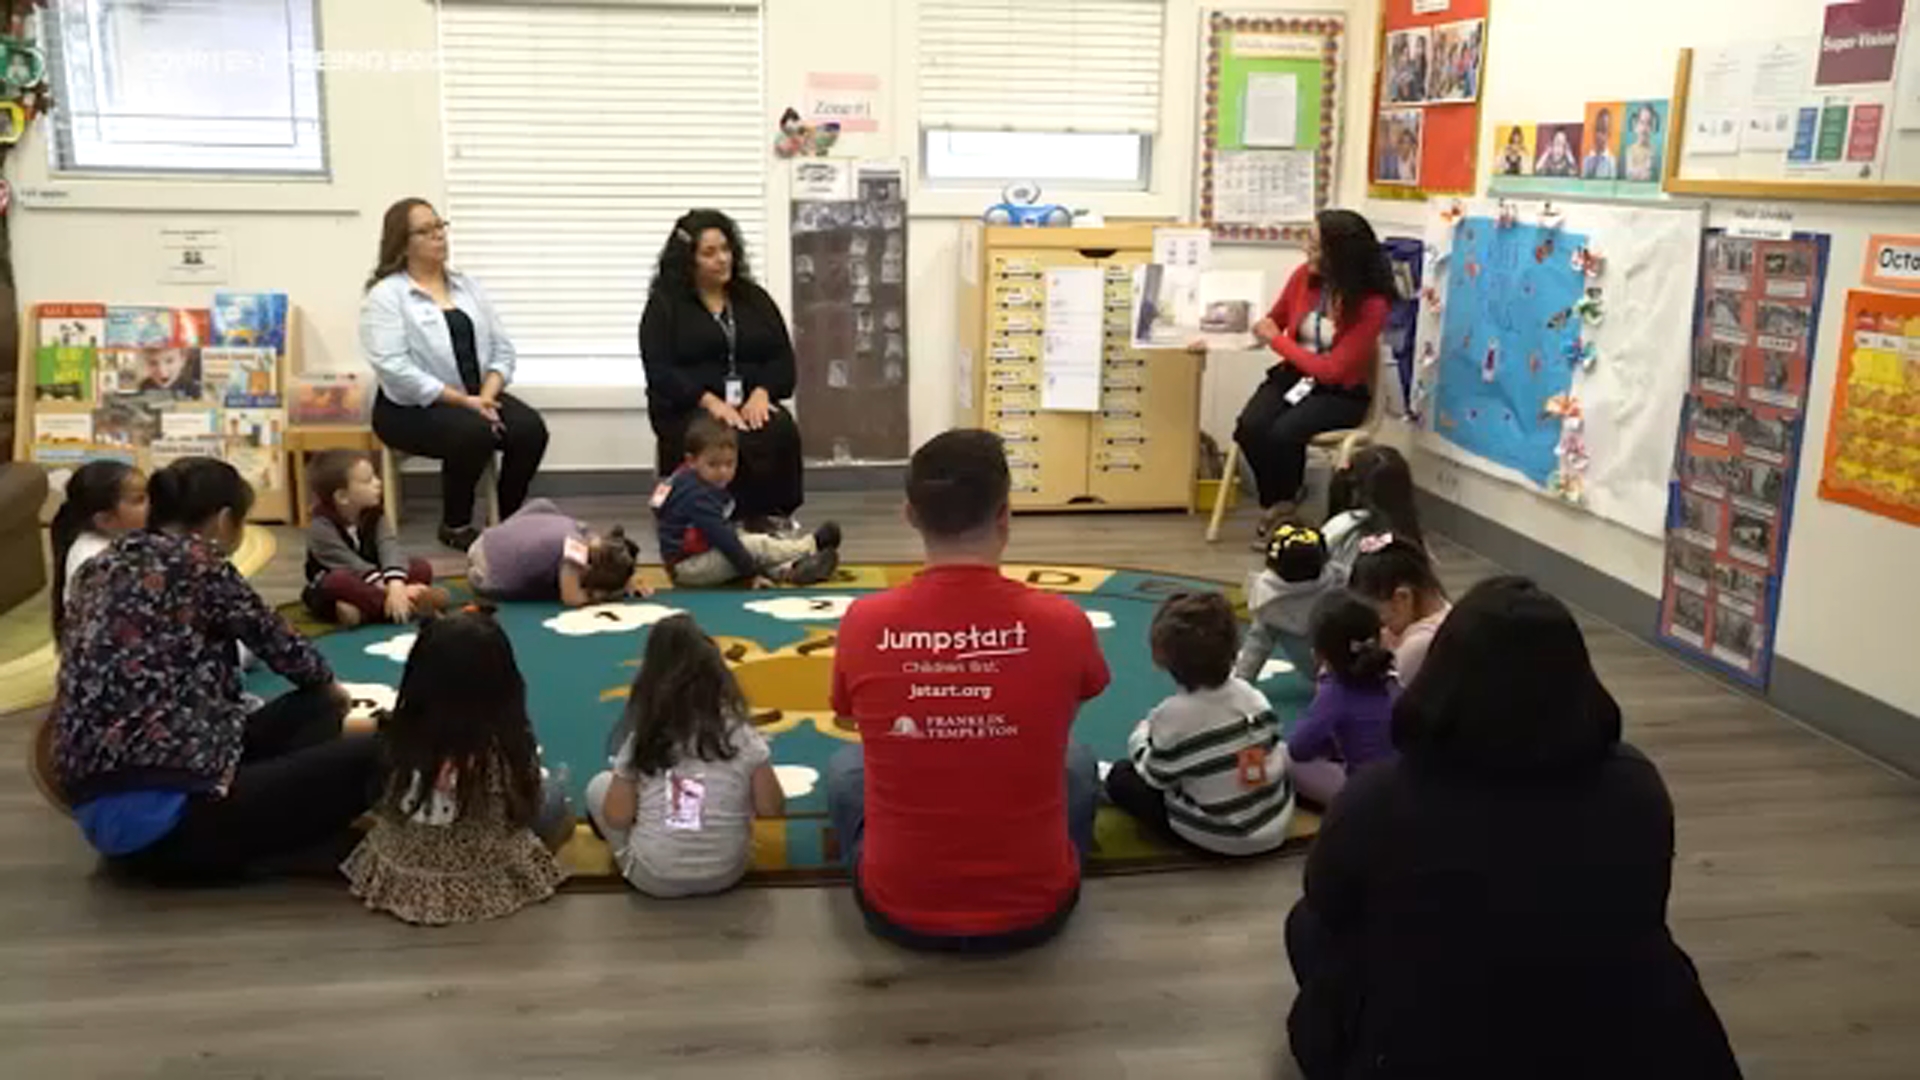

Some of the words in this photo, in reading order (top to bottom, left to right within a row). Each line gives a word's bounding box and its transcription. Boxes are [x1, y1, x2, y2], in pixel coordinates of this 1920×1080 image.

[1026, 570, 1081, 586] D
[876, 620, 1027, 655] Jumpstart
[907, 683, 993, 700] jstart.org
[925, 713, 1006, 728] FRANKLIN
[926, 724, 1019, 740] TEMPLETON
